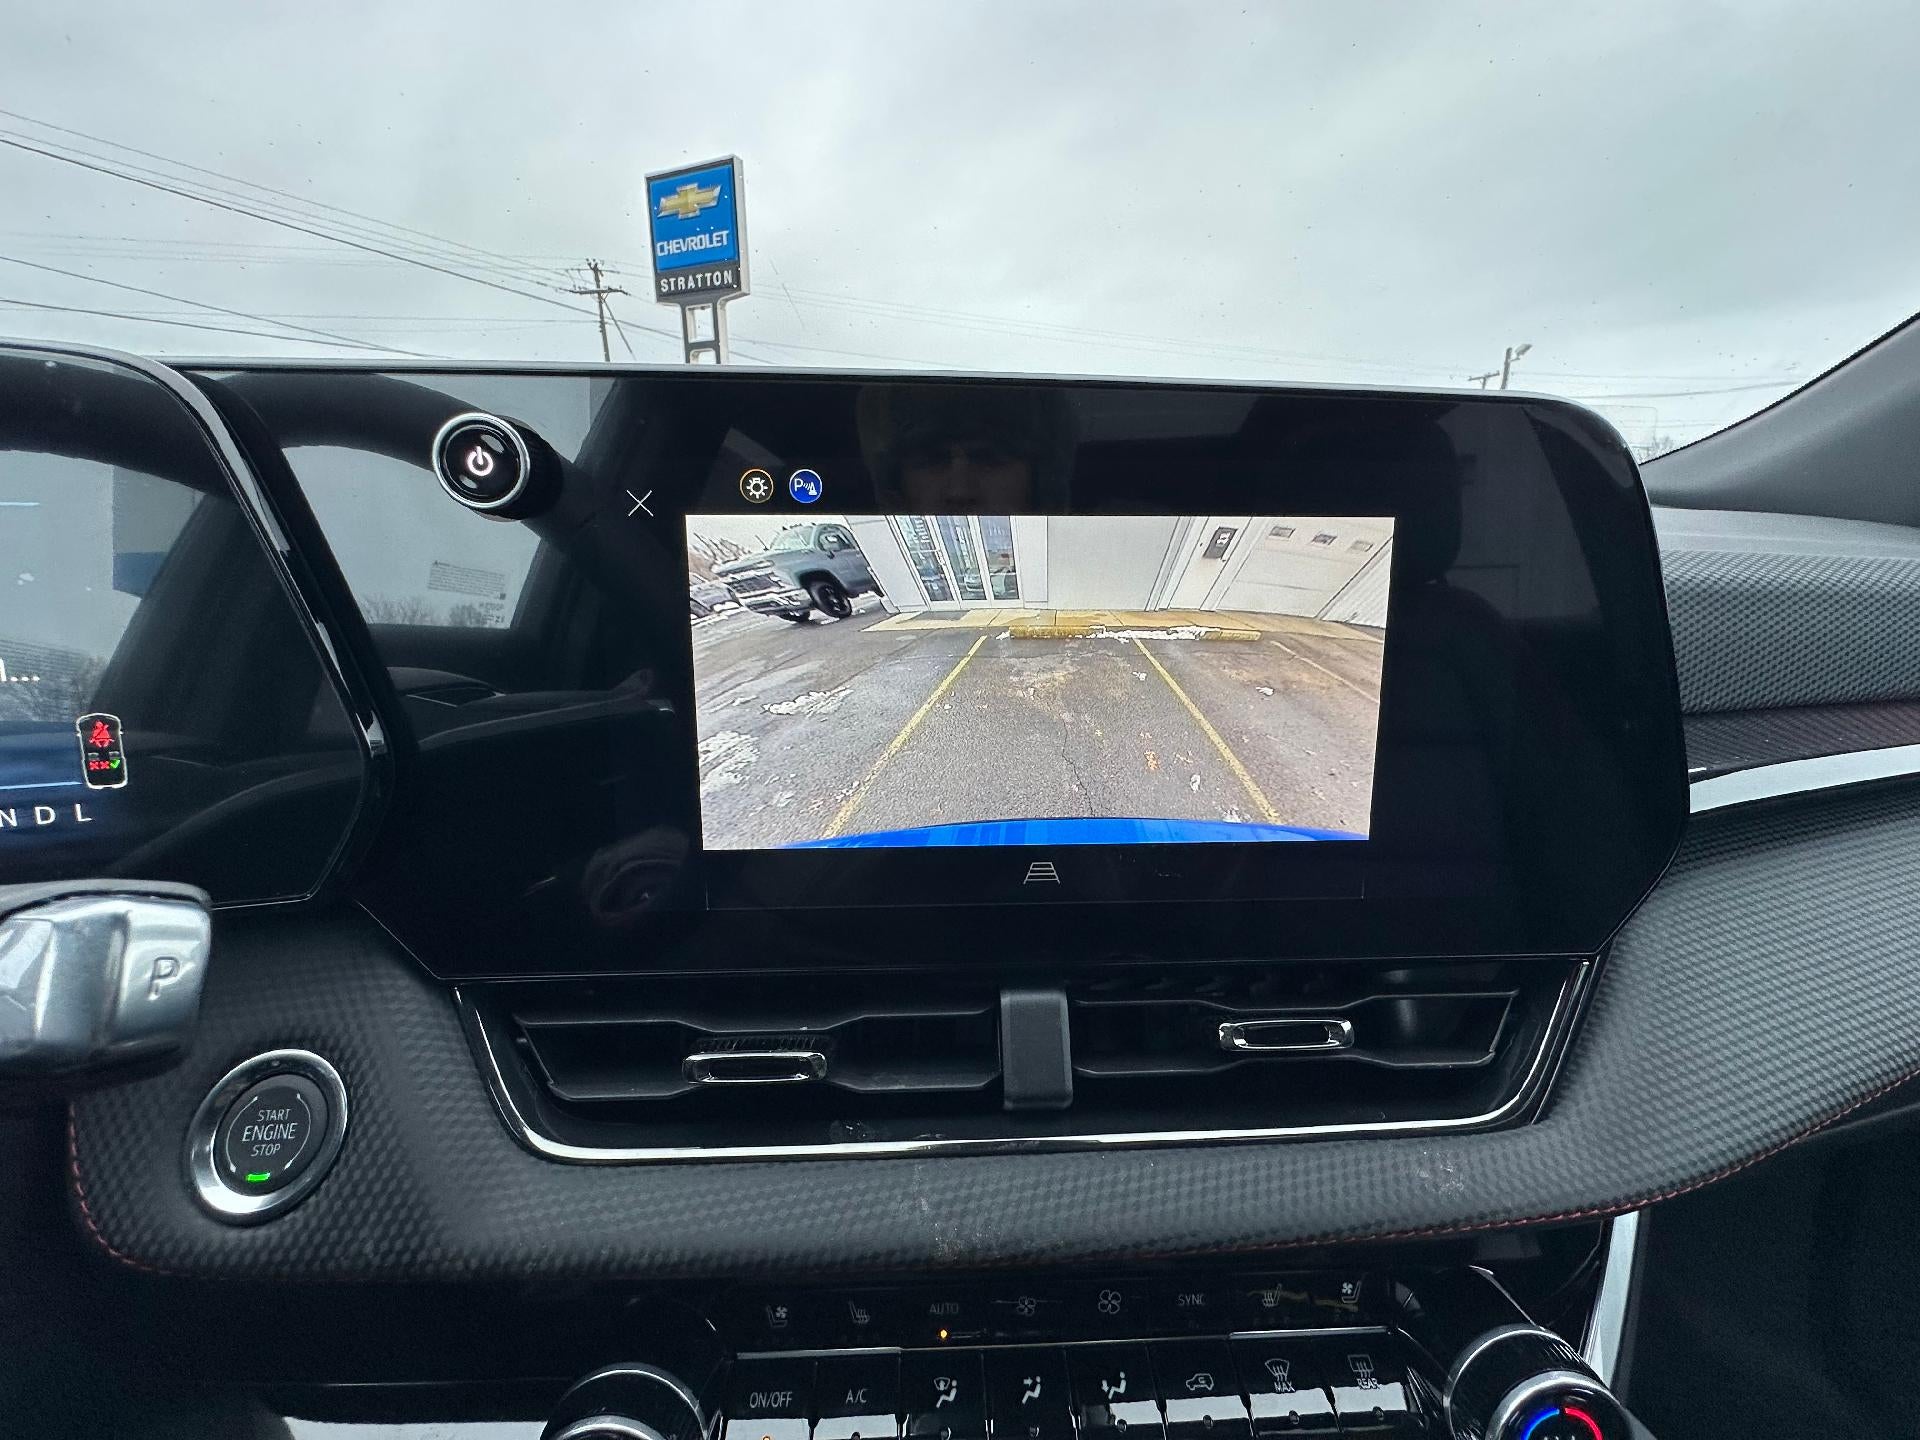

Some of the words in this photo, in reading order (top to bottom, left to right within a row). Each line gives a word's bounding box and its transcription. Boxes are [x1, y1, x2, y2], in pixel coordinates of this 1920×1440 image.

[656, 230, 730, 257] CHEVROLET
[660, 269, 733, 292] STRATTON
[34, 805, 57, 825] D
[75, 803, 94, 823] L
[148, 956, 181, 1001] P
[256, 1108, 292, 1122] START
[241, 1122, 299, 1143] ENGINE
[250, 1143, 281, 1157] STOP
[1177, 1292, 1206, 1307] SYNC
[929, 1302, 959, 1315] AUTO
[1273, 1381, 1296, 1393] MAX
[1356, 1378, 1379, 1390] REAR
[749, 1390, 793, 1409] ON/OFF
[845, 1388, 868, 1405] A/C
